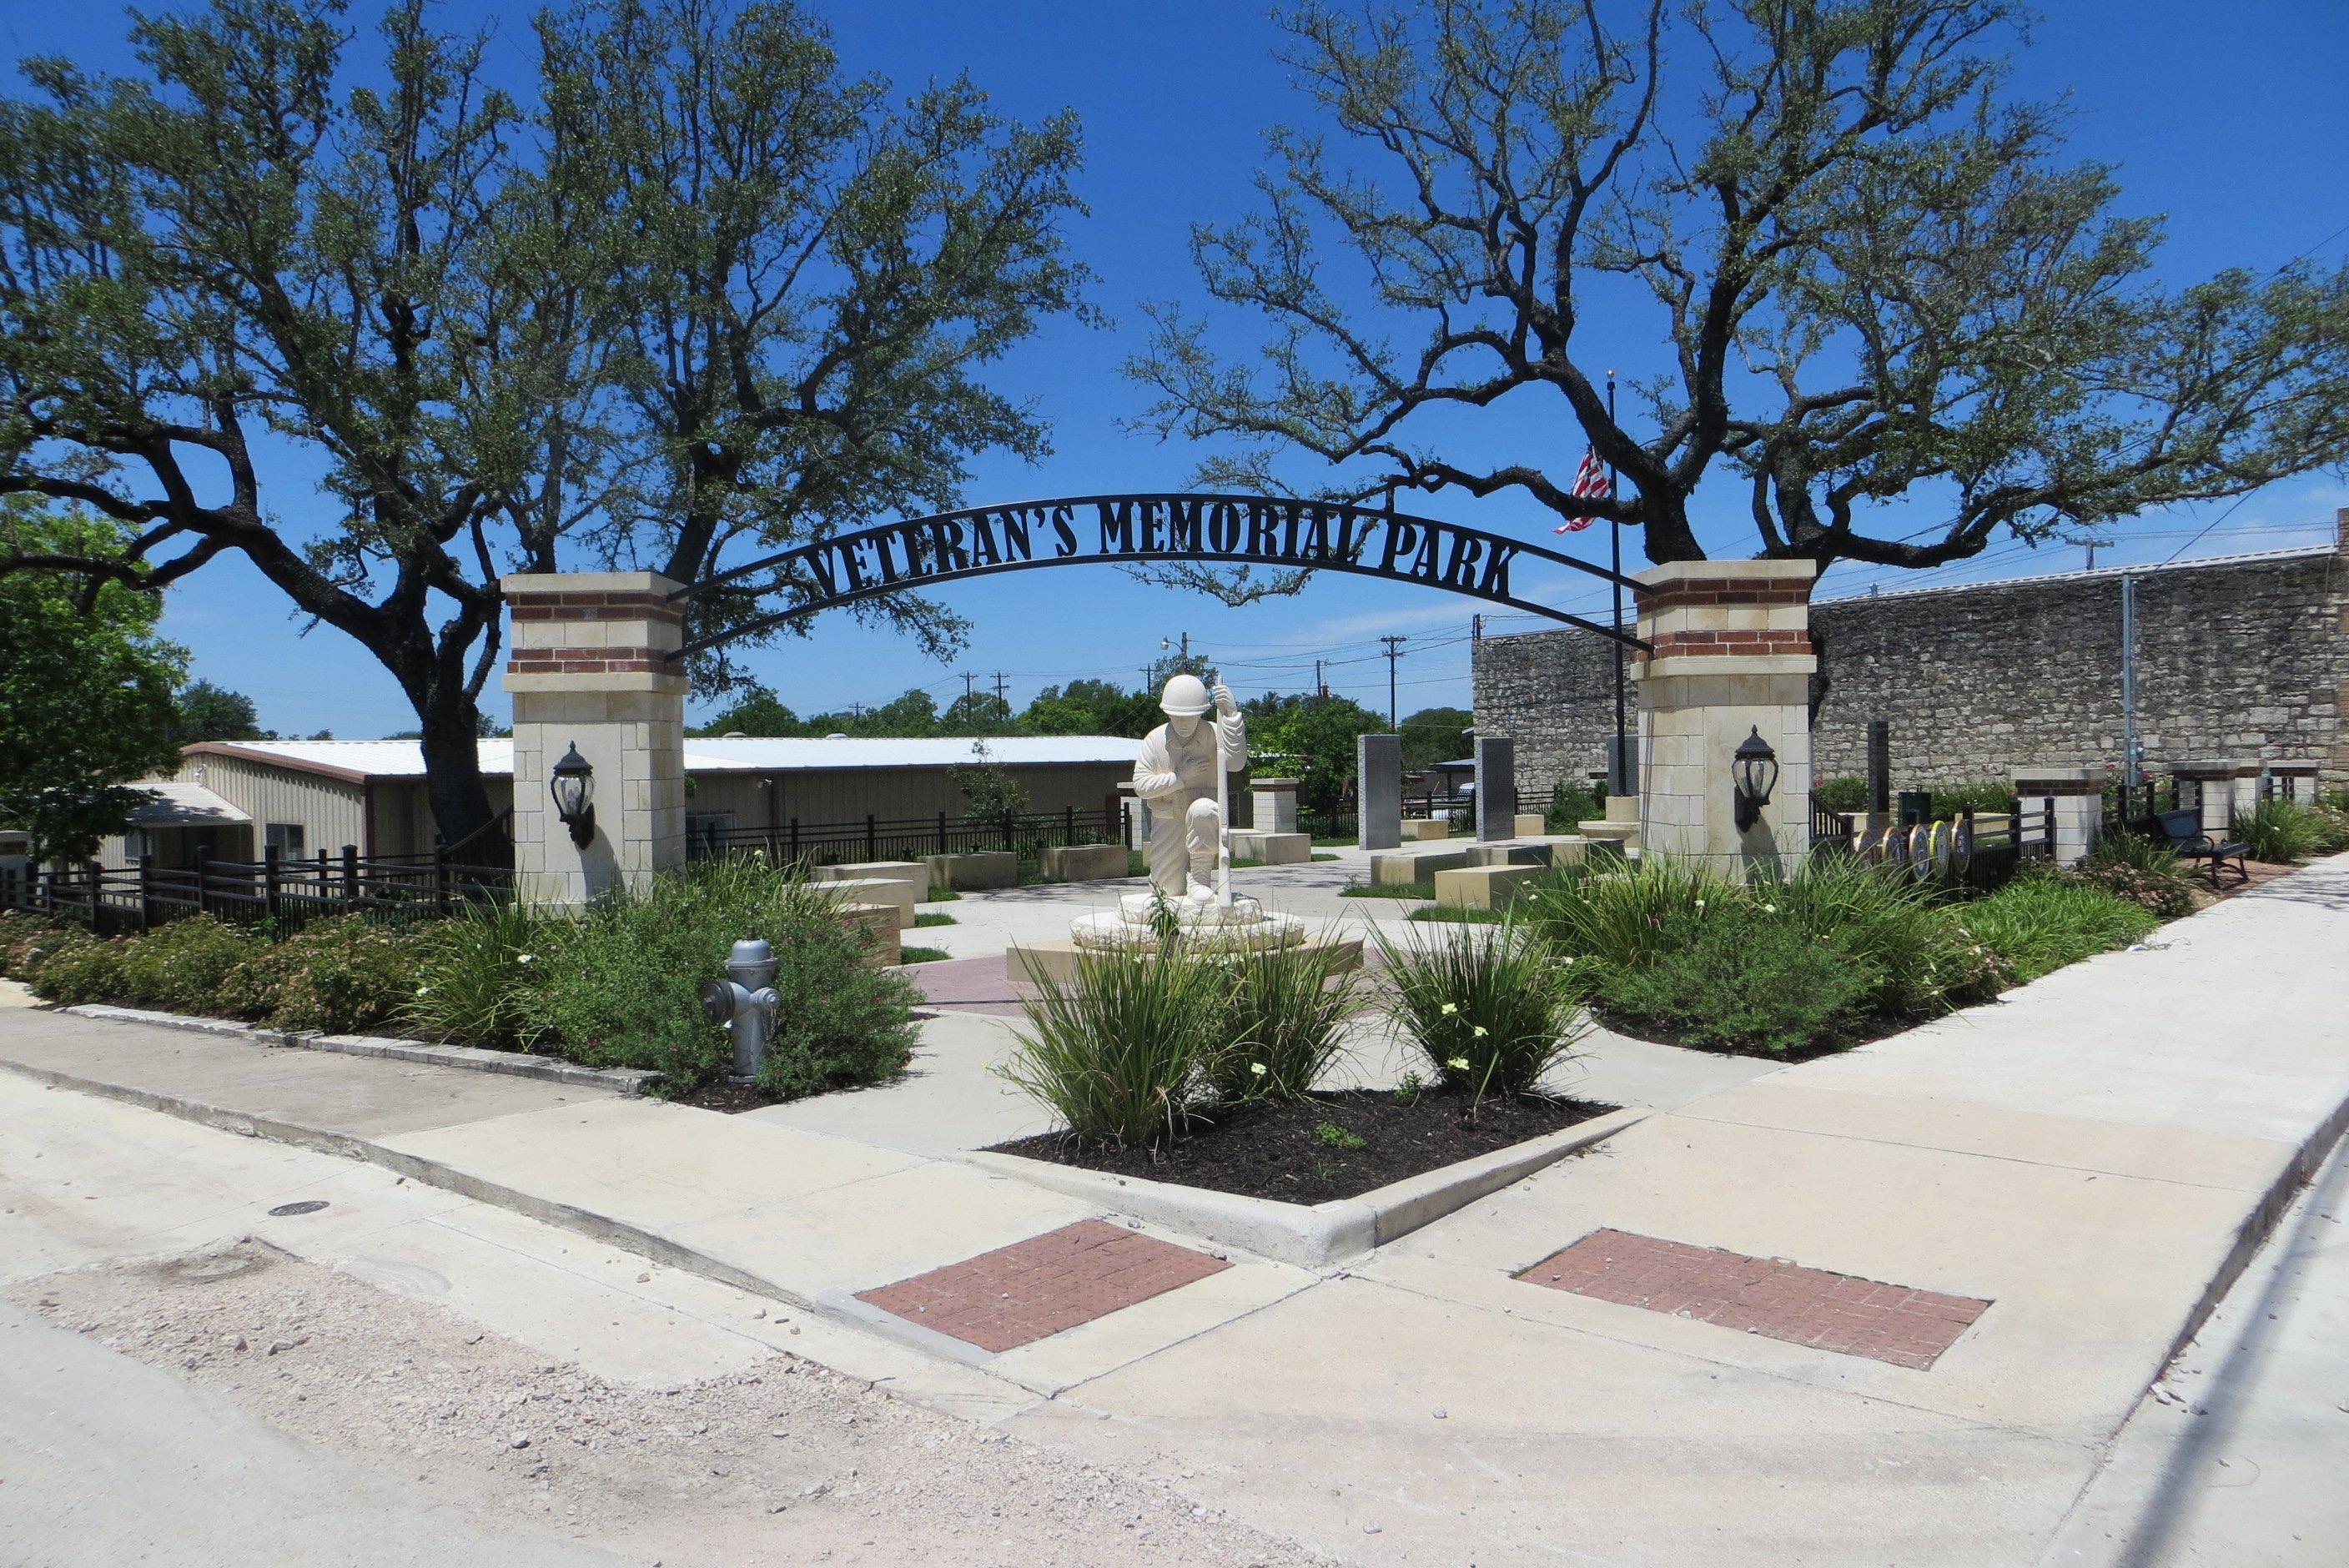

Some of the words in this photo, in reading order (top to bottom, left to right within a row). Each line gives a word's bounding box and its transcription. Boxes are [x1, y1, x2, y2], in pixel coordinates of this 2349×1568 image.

[802, 503, 1078, 598] VETERAN'S
[1096, 500, 1358, 564] MEMORIAL
[1378, 515, 1520, 598] PARK
